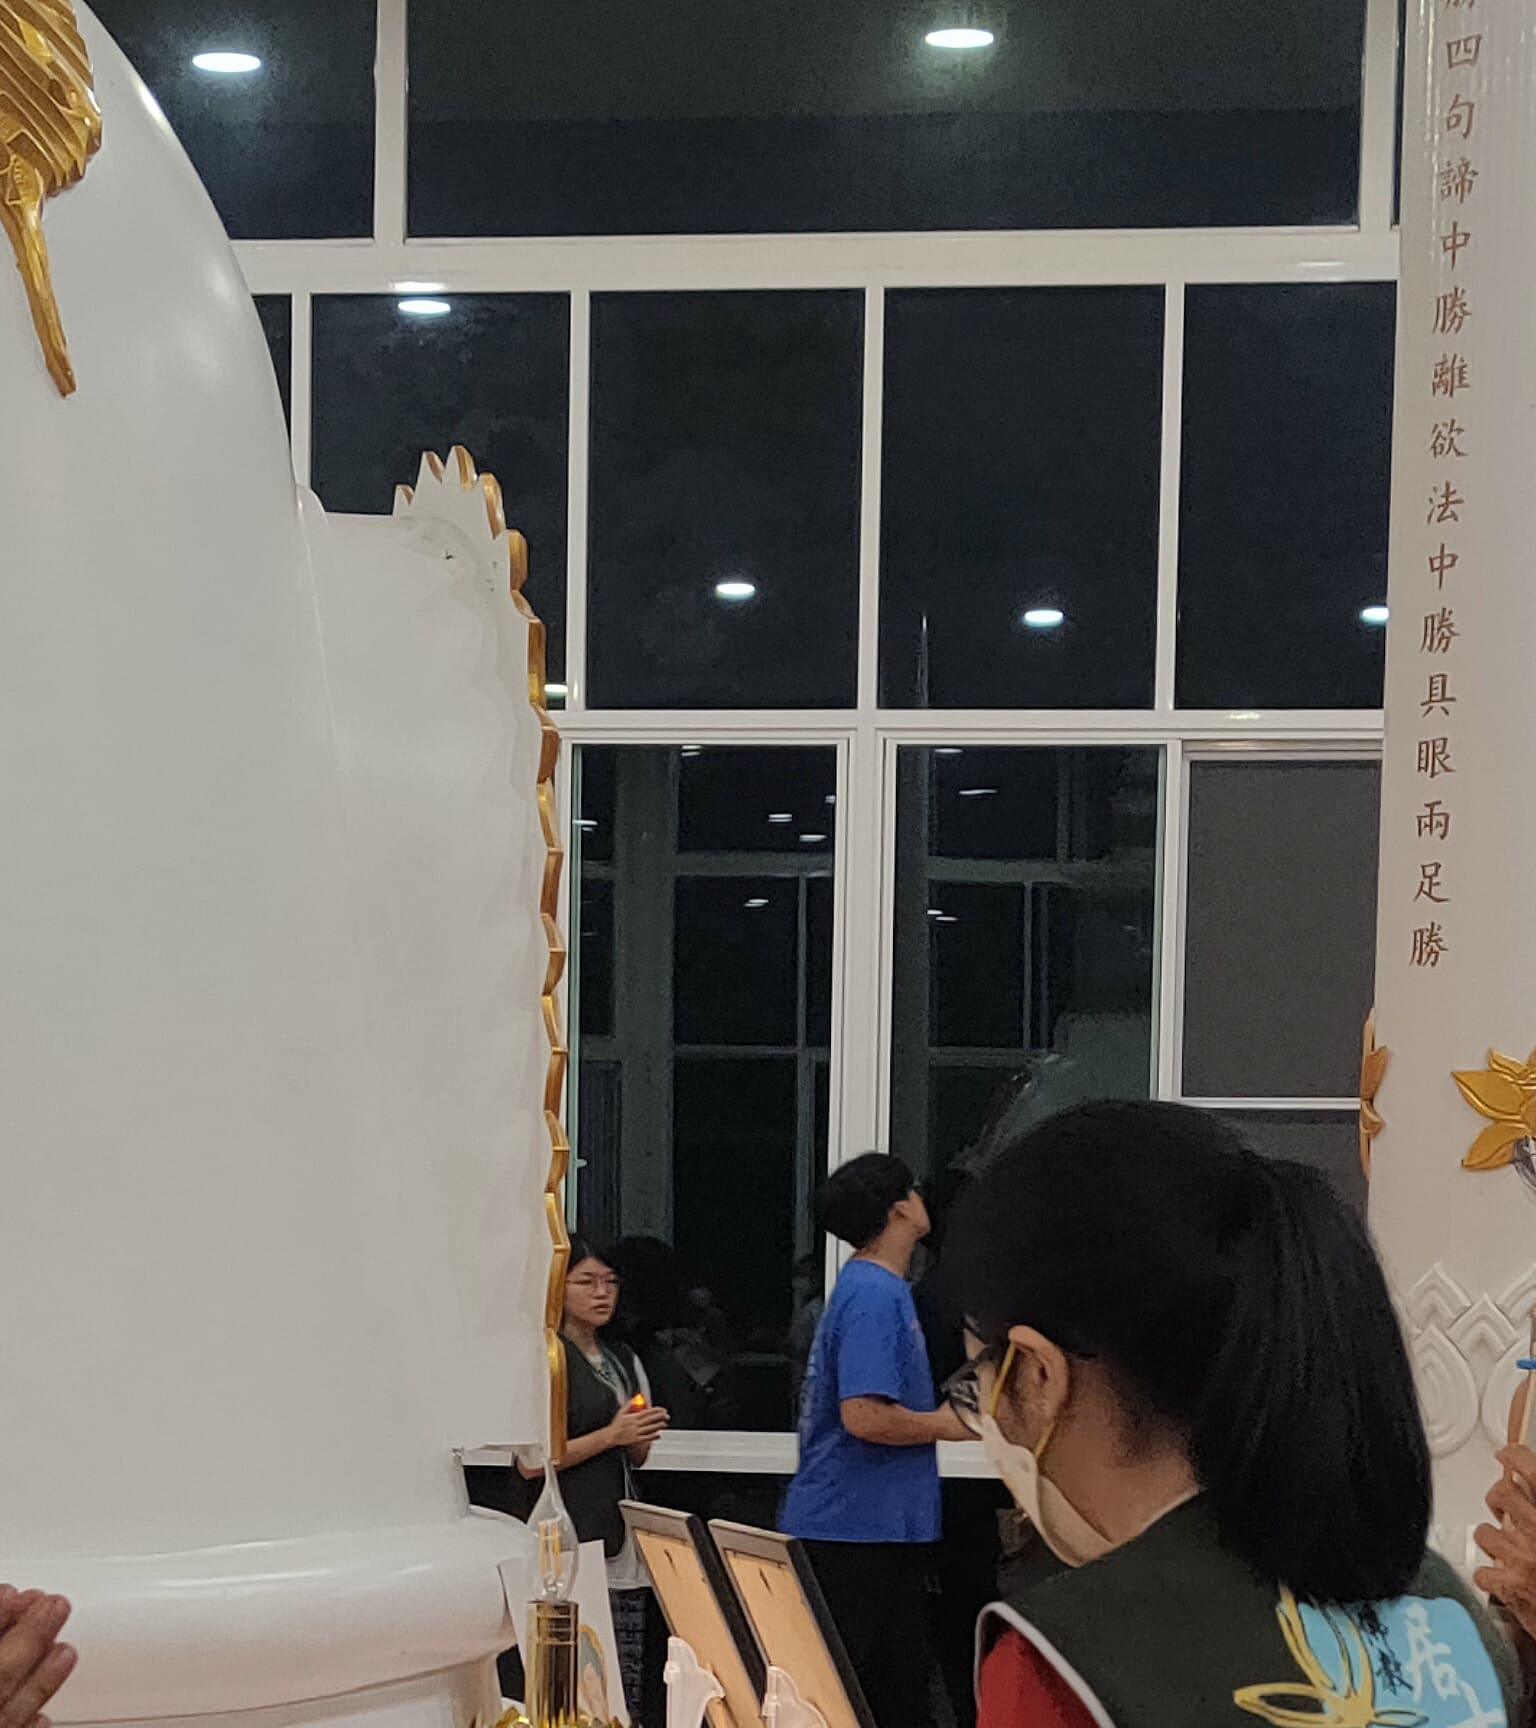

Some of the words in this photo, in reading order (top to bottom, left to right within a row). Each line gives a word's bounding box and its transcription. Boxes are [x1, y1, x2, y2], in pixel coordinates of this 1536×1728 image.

[1409, 0, 1483, 968] 四句諦中勝離欲法中勝具眼兩足勝
